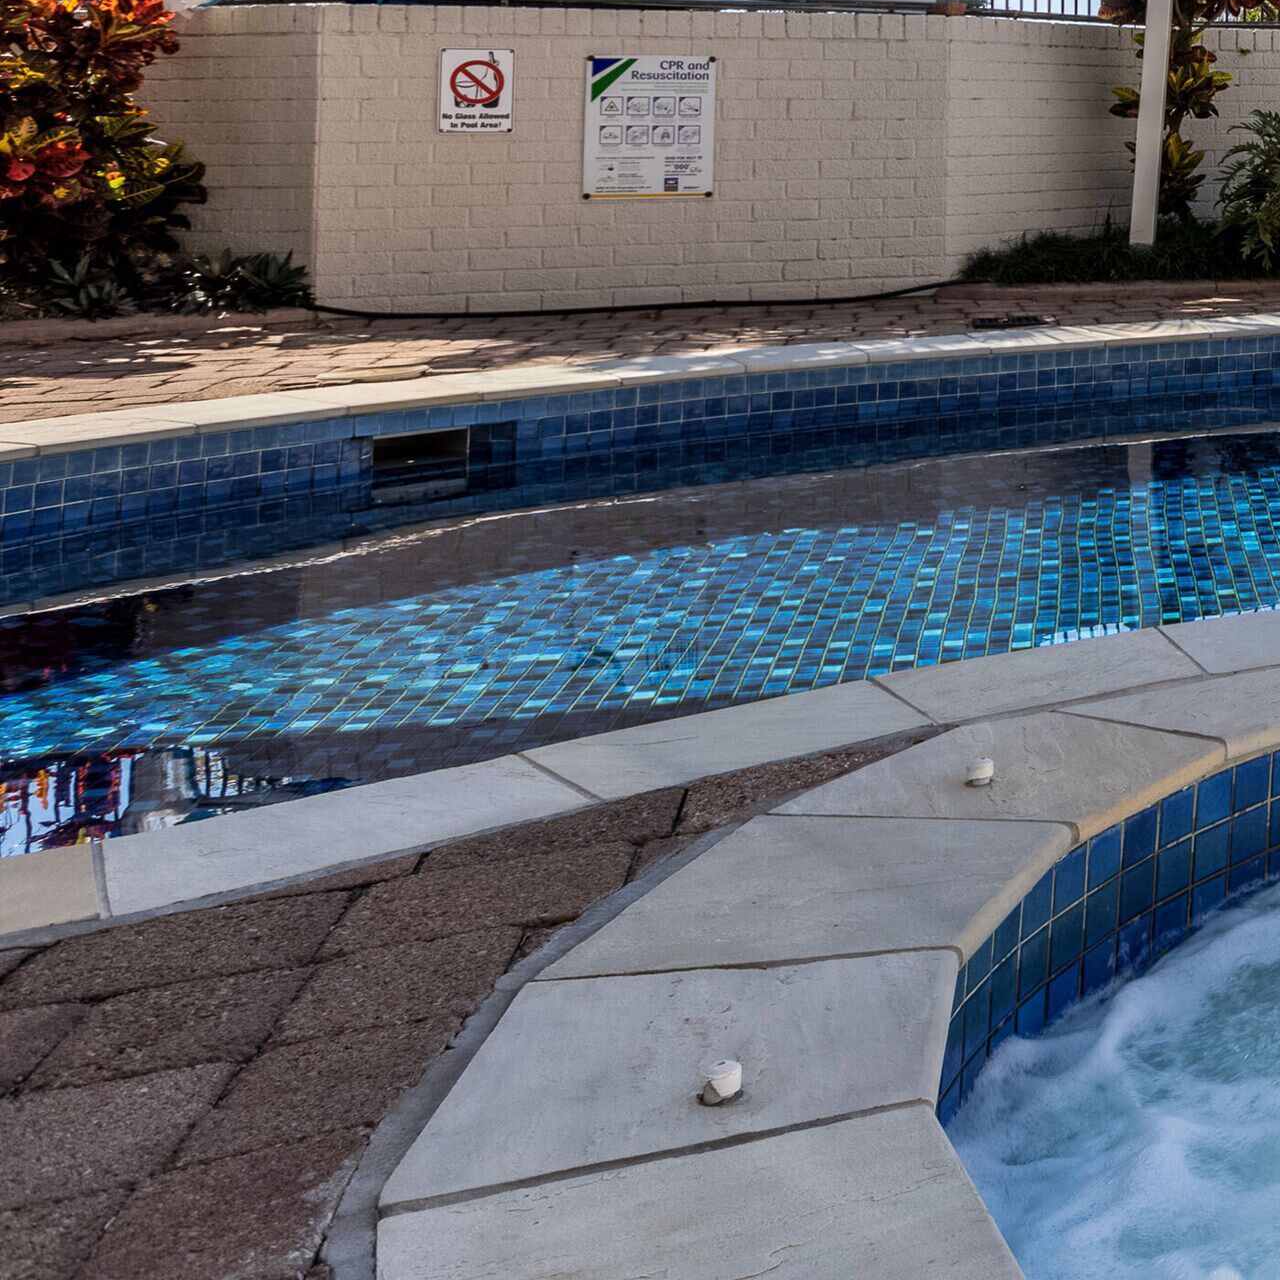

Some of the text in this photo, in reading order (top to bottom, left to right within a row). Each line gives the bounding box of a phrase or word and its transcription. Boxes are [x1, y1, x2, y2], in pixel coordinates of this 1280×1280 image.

[660, 60, 710, 71] CPR and
[631, 70, 710, 81] Resuscitation
